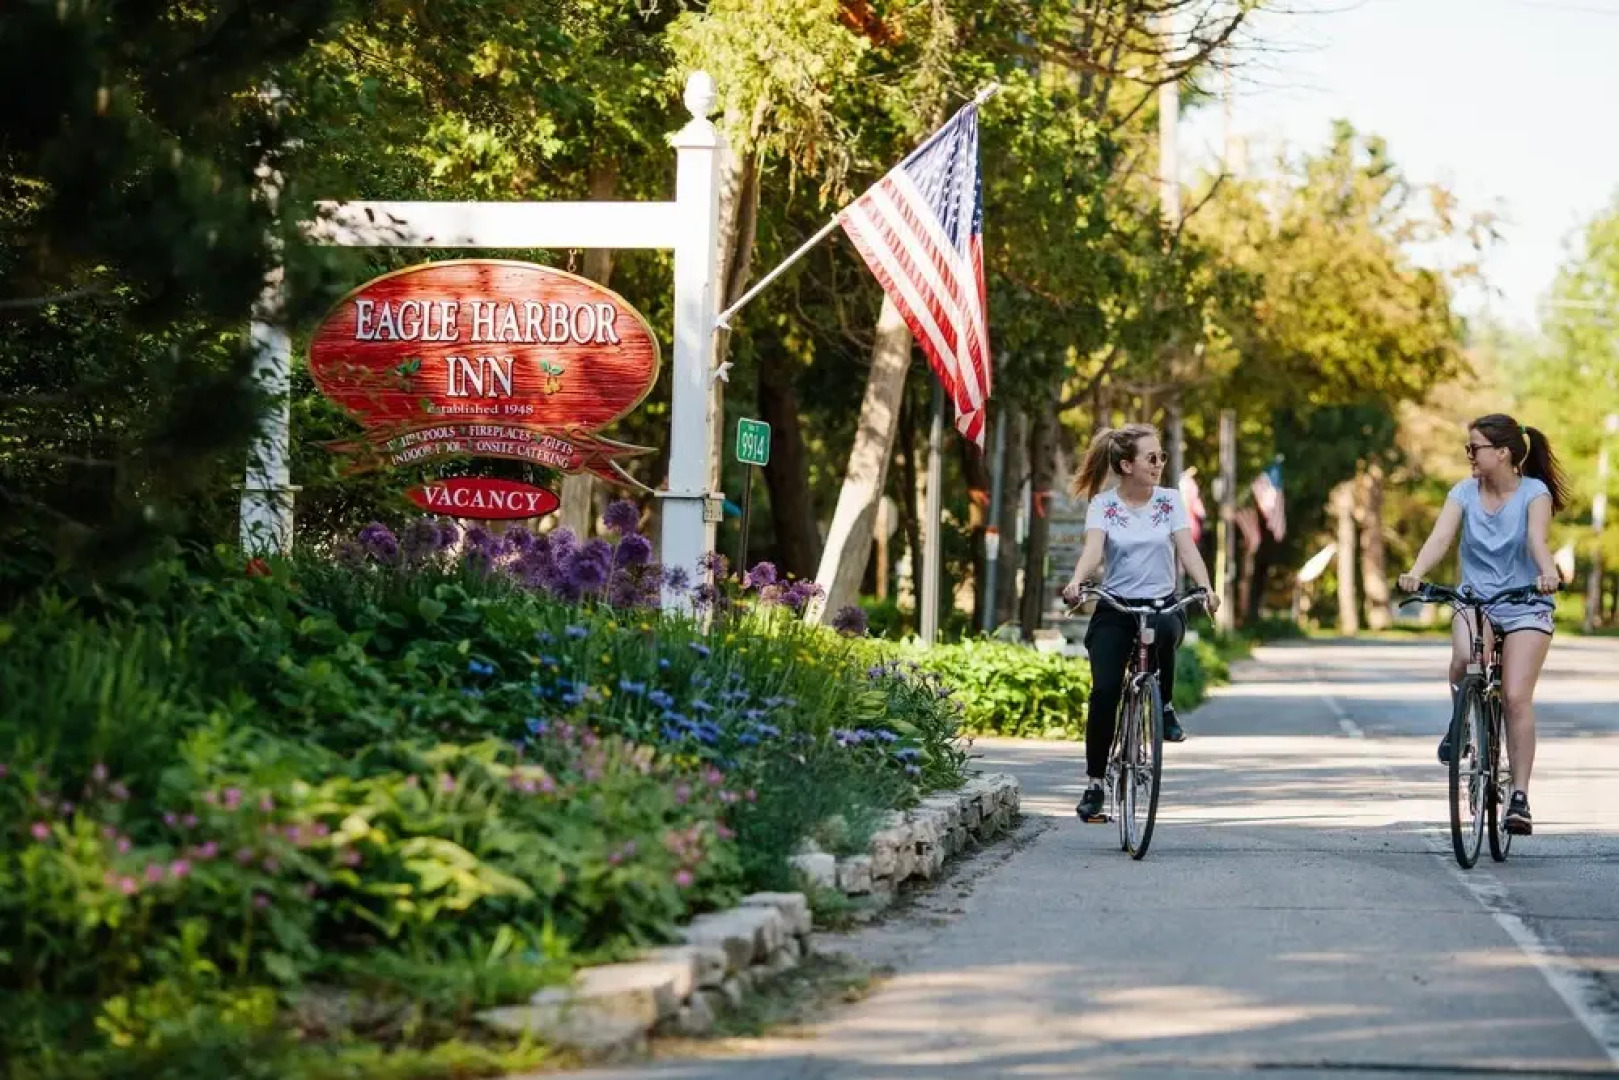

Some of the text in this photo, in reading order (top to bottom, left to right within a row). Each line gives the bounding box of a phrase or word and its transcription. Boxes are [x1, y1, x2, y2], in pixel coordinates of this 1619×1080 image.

[355, 299, 621, 345] EAGLE HARBOR
[445, 355, 514, 398] INN
[504, 404, 534, 415] 1948
[386, 425, 574, 455] WIRLPOOLS FIREPLACES GIFTS
[477, 441, 514, 454] ONSITE
[517, 445, 570, 469] CATERING
[742, 431, 765, 461] 9914
[424, 485, 541, 511] VACANCY
